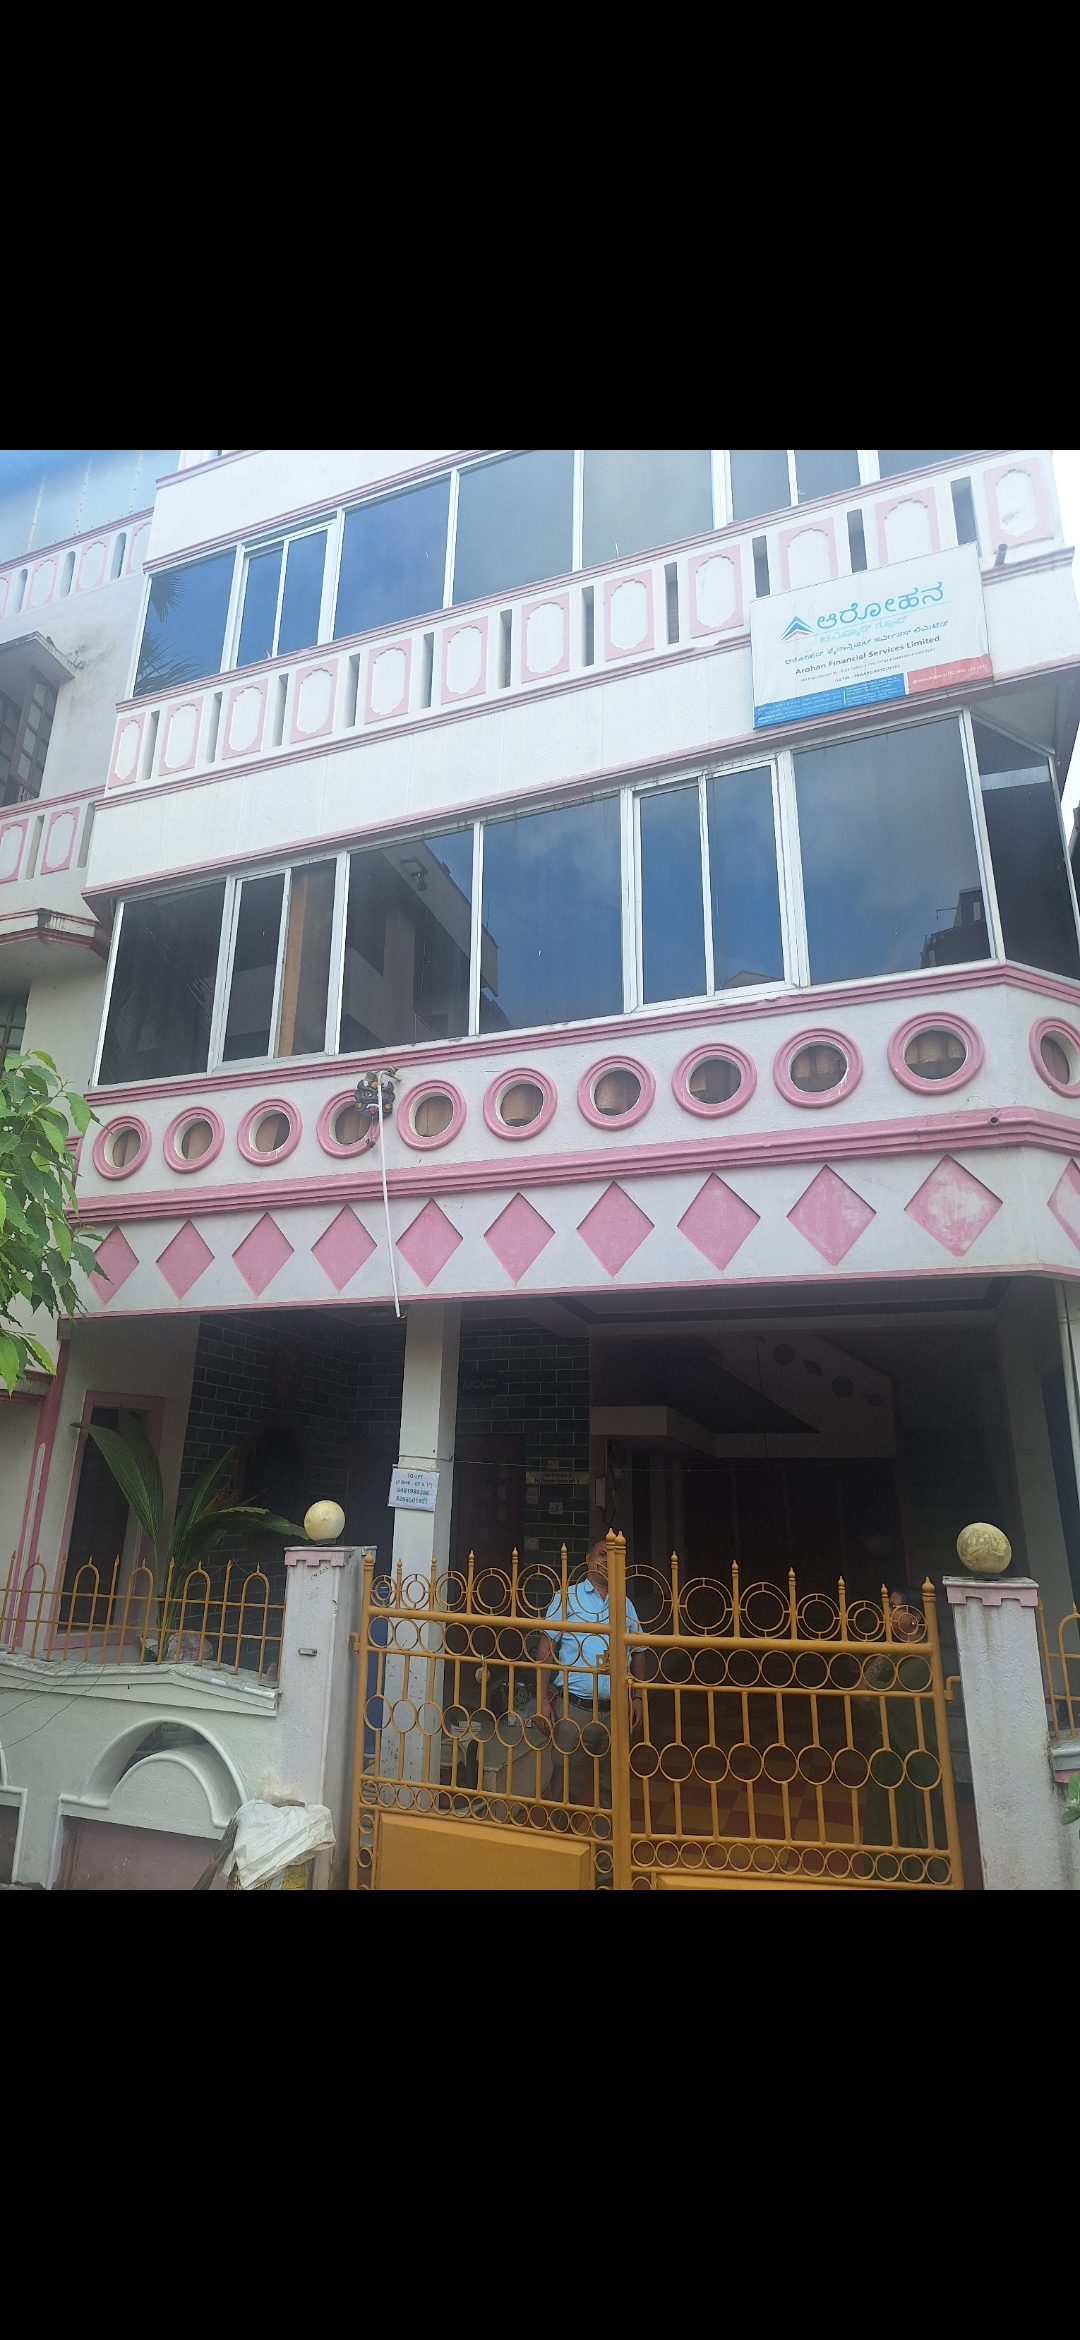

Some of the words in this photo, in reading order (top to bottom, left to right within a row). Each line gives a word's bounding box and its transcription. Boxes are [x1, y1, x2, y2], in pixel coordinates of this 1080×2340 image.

[816, 581, 944, 630] ಆರೋಹನ
[795, 664, 827, 675] Arohan
[828, 652, 866, 667] Financial
[868, 645, 904, 658] Services
[906, 635, 941, 649] Limited
